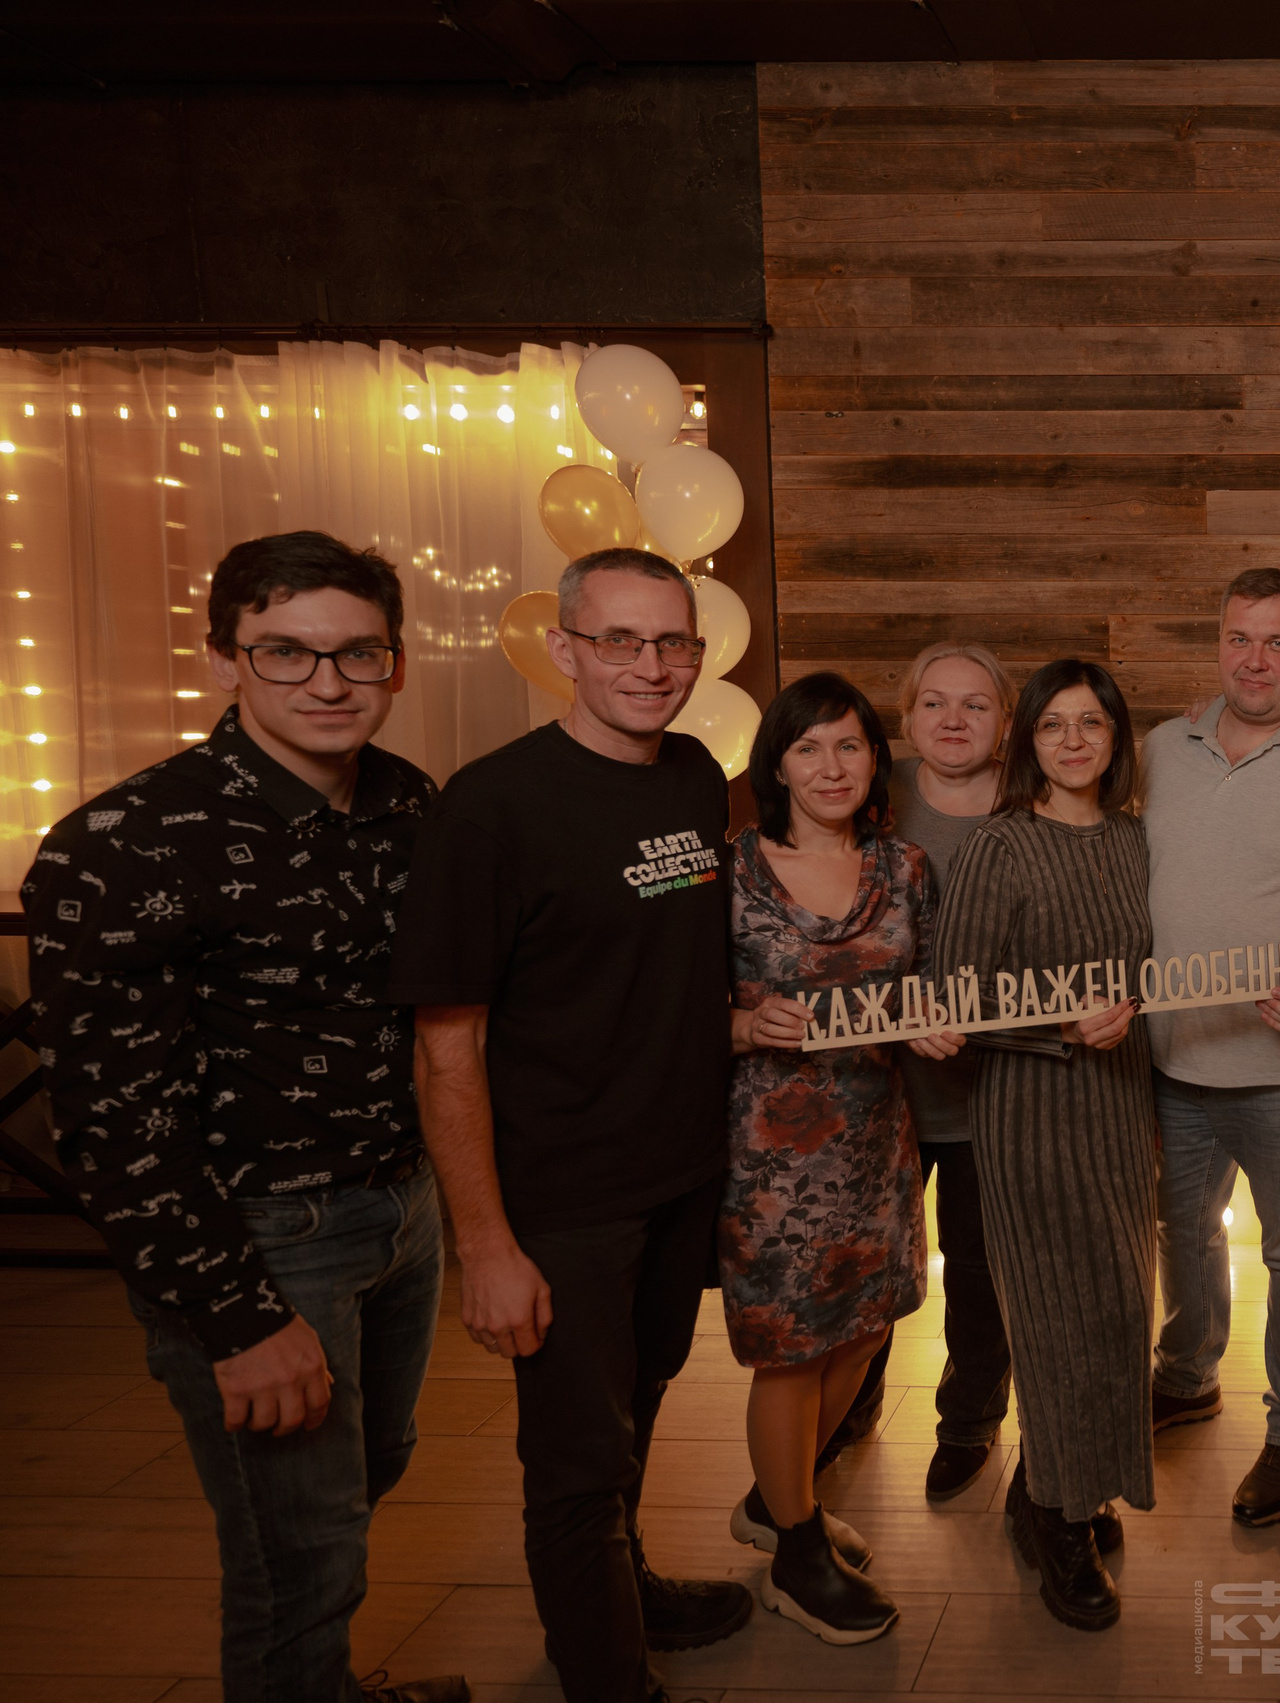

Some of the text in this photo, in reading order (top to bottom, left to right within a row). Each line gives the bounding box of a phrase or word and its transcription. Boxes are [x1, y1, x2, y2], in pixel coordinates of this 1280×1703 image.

[638, 830, 703, 860] EARTH
[623, 848, 720, 887] COLLECTIVE
[638, 869, 717, 899] Equipe du Monde
[797, 964, 982, 1042] КАЖДЫЙ
[996, 958, 1128, 1020] ВАЖЕН
